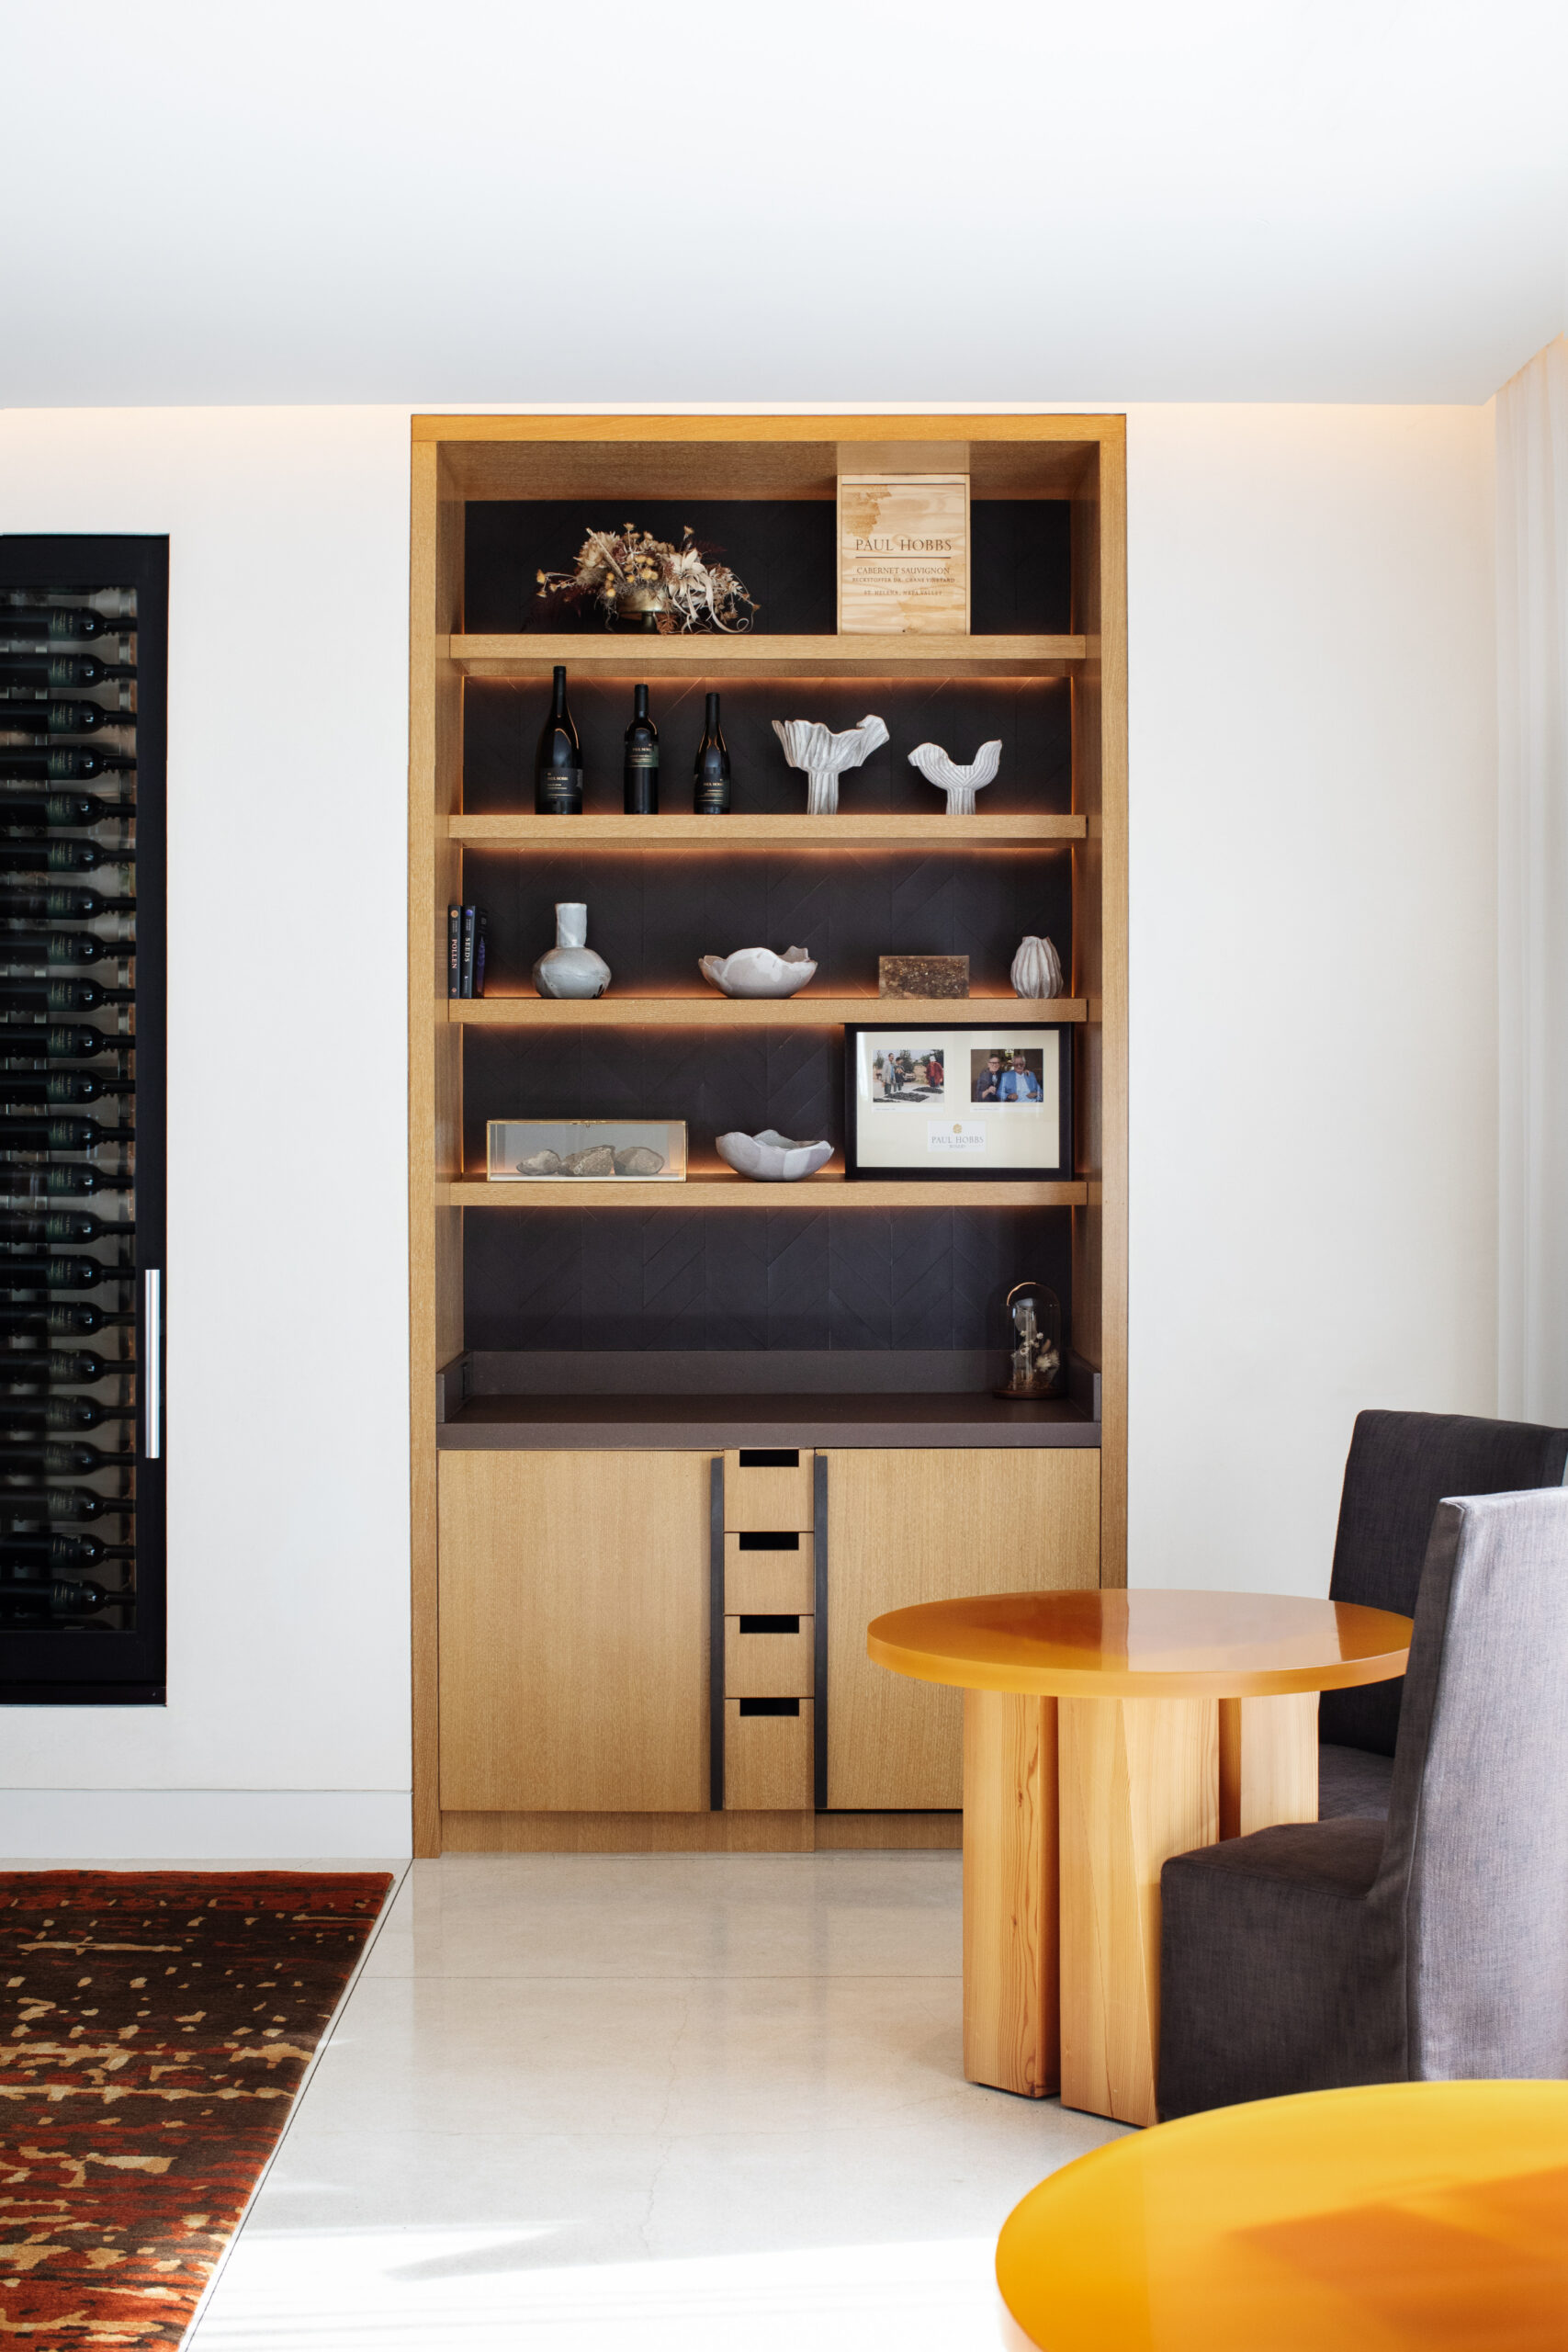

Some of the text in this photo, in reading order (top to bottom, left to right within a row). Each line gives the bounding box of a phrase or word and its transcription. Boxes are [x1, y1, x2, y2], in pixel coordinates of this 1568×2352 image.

[855, 539, 953, 551] PAUL HOBBS
[931, 1136, 985, 1144] PAUL HOBBS
